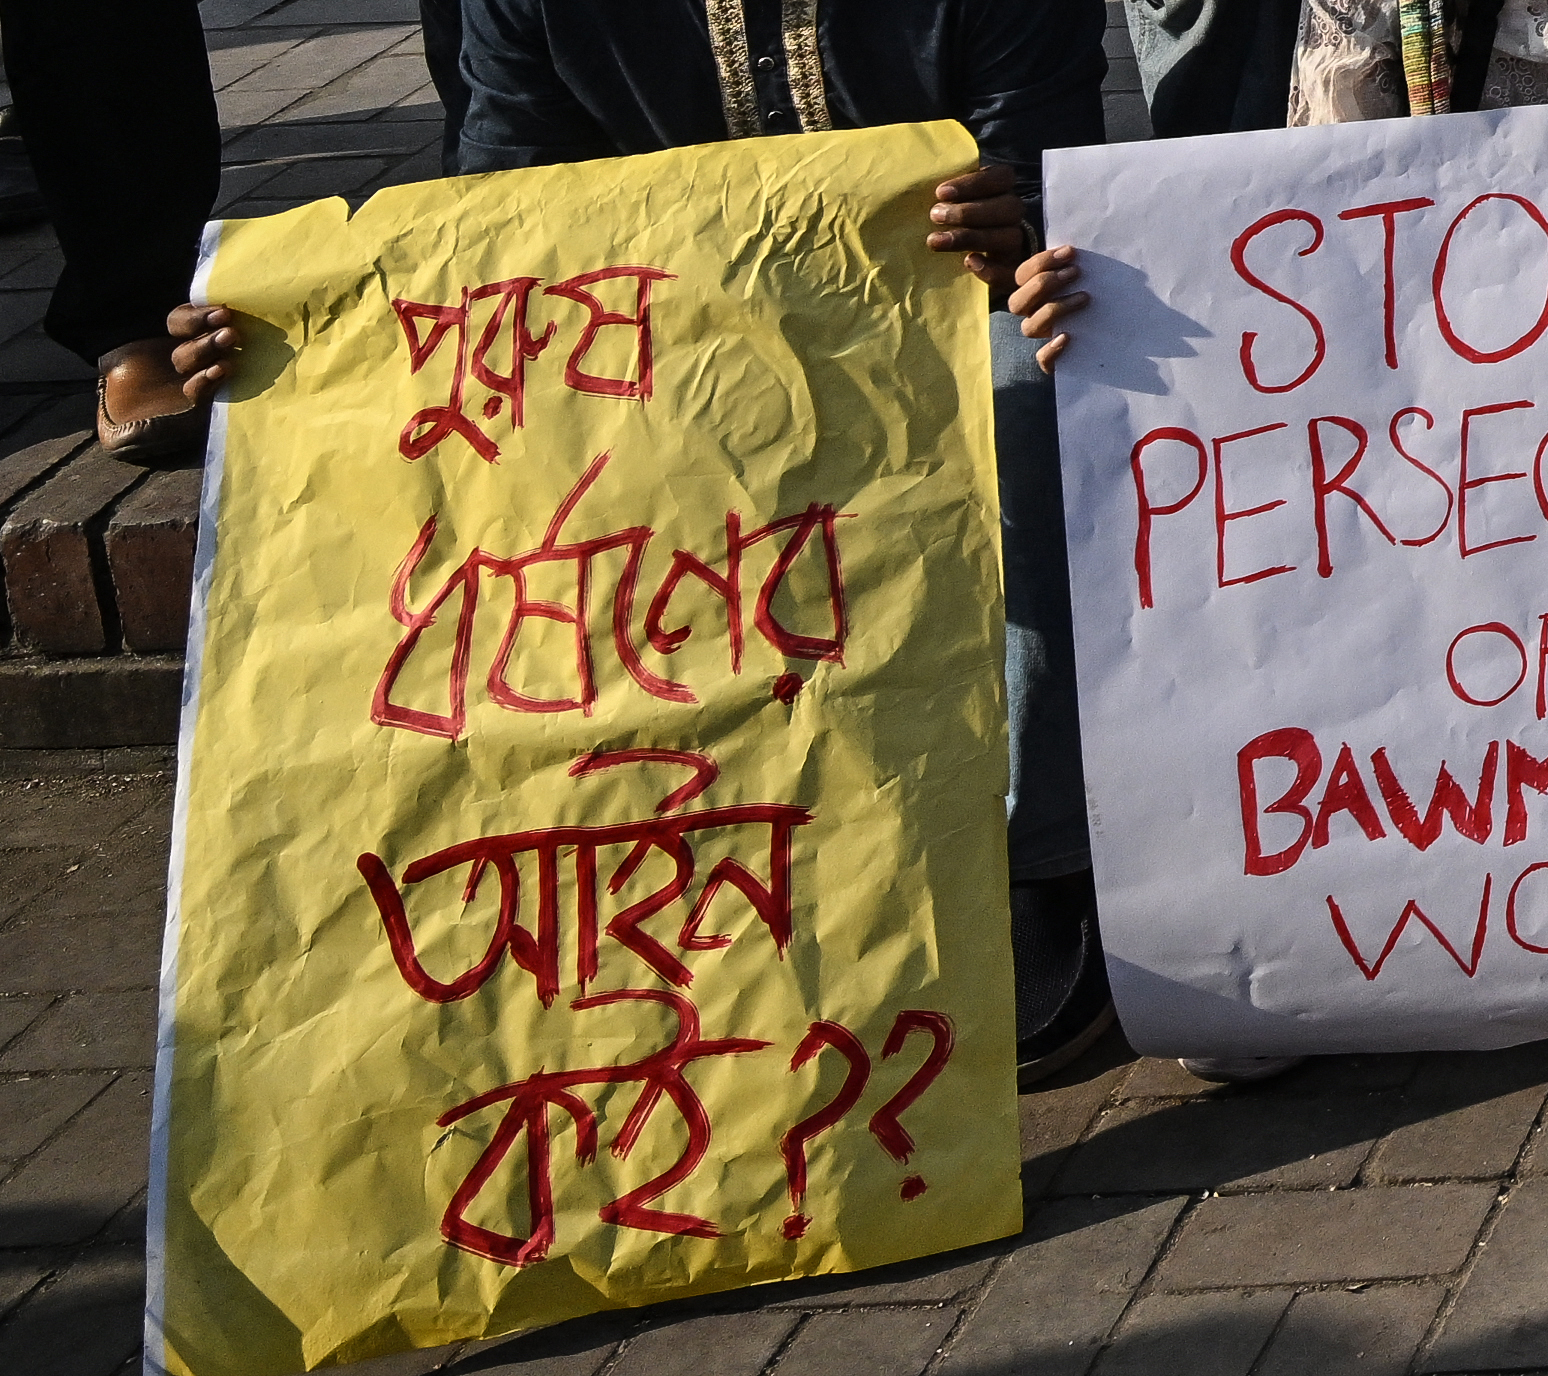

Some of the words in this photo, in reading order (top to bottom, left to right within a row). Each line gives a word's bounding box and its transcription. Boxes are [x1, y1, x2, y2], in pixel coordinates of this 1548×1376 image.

[393, 262, 682, 464] পুরুষ
[370, 448, 858, 742] ধর্ষণের
[356, 748, 814, 1010] আইন
